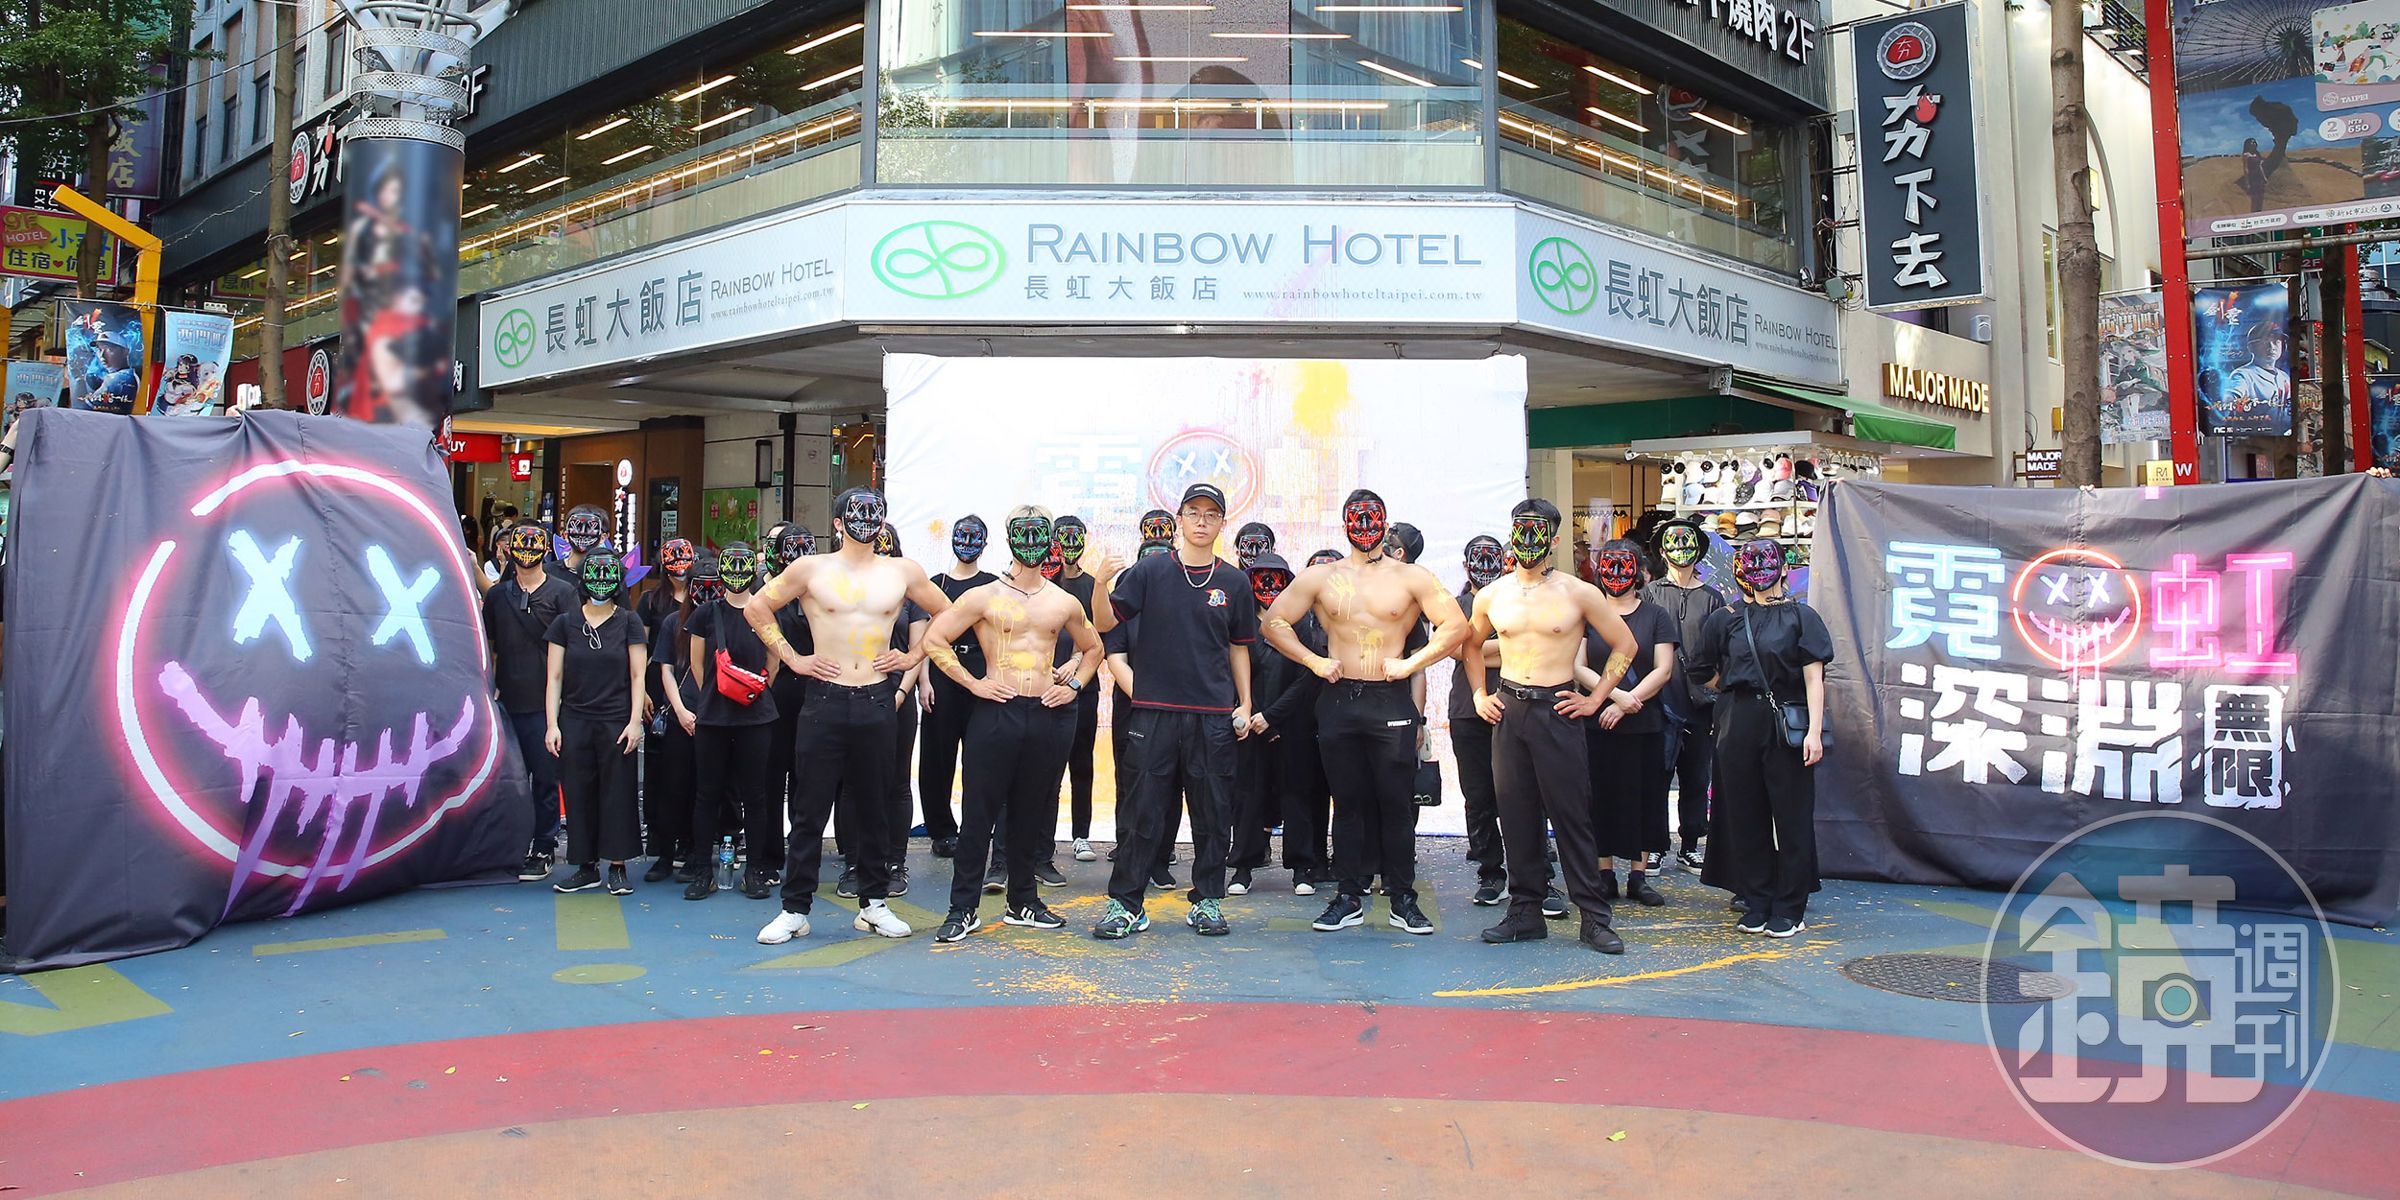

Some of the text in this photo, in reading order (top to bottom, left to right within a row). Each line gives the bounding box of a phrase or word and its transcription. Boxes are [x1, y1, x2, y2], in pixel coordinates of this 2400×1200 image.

[1784, 9, 1816, 65] 2F
[2327, 121, 2338, 133] 2
[2347, 124, 2370, 133] 650
[1882, 84, 1948, 288] 夯下去
[5, 231, 48, 243] HOTEL
[1028, 223, 1481, 266] RAINBOW HOTEL
[8, 248, 50, 269] 住宿
[2301, 258, 2321, 268] 2F
[711, 258, 834, 301] RAINBOW HOTEL
[1024, 275, 1217, 301] 長虹大飯店
[1243, 287, 1483, 303] www.rainbowhoteltaipei.com.tw
[545, 269, 703, 354] 長虹大飯店
[1604, 259, 1748, 347] 長虹大飯店
[1754, 313, 1838, 350] RAINBOW HOTEL
[1889, 363, 1989, 414] MAJOR MADE
[2027, 451, 2062, 462] MAJOR
[2027, 461, 2057, 472] MADE
[2174, 462, 2193, 477] W
[1885, 541, 2299, 675] 霓 虹
[1898, 662, 2185, 805] 深淵
